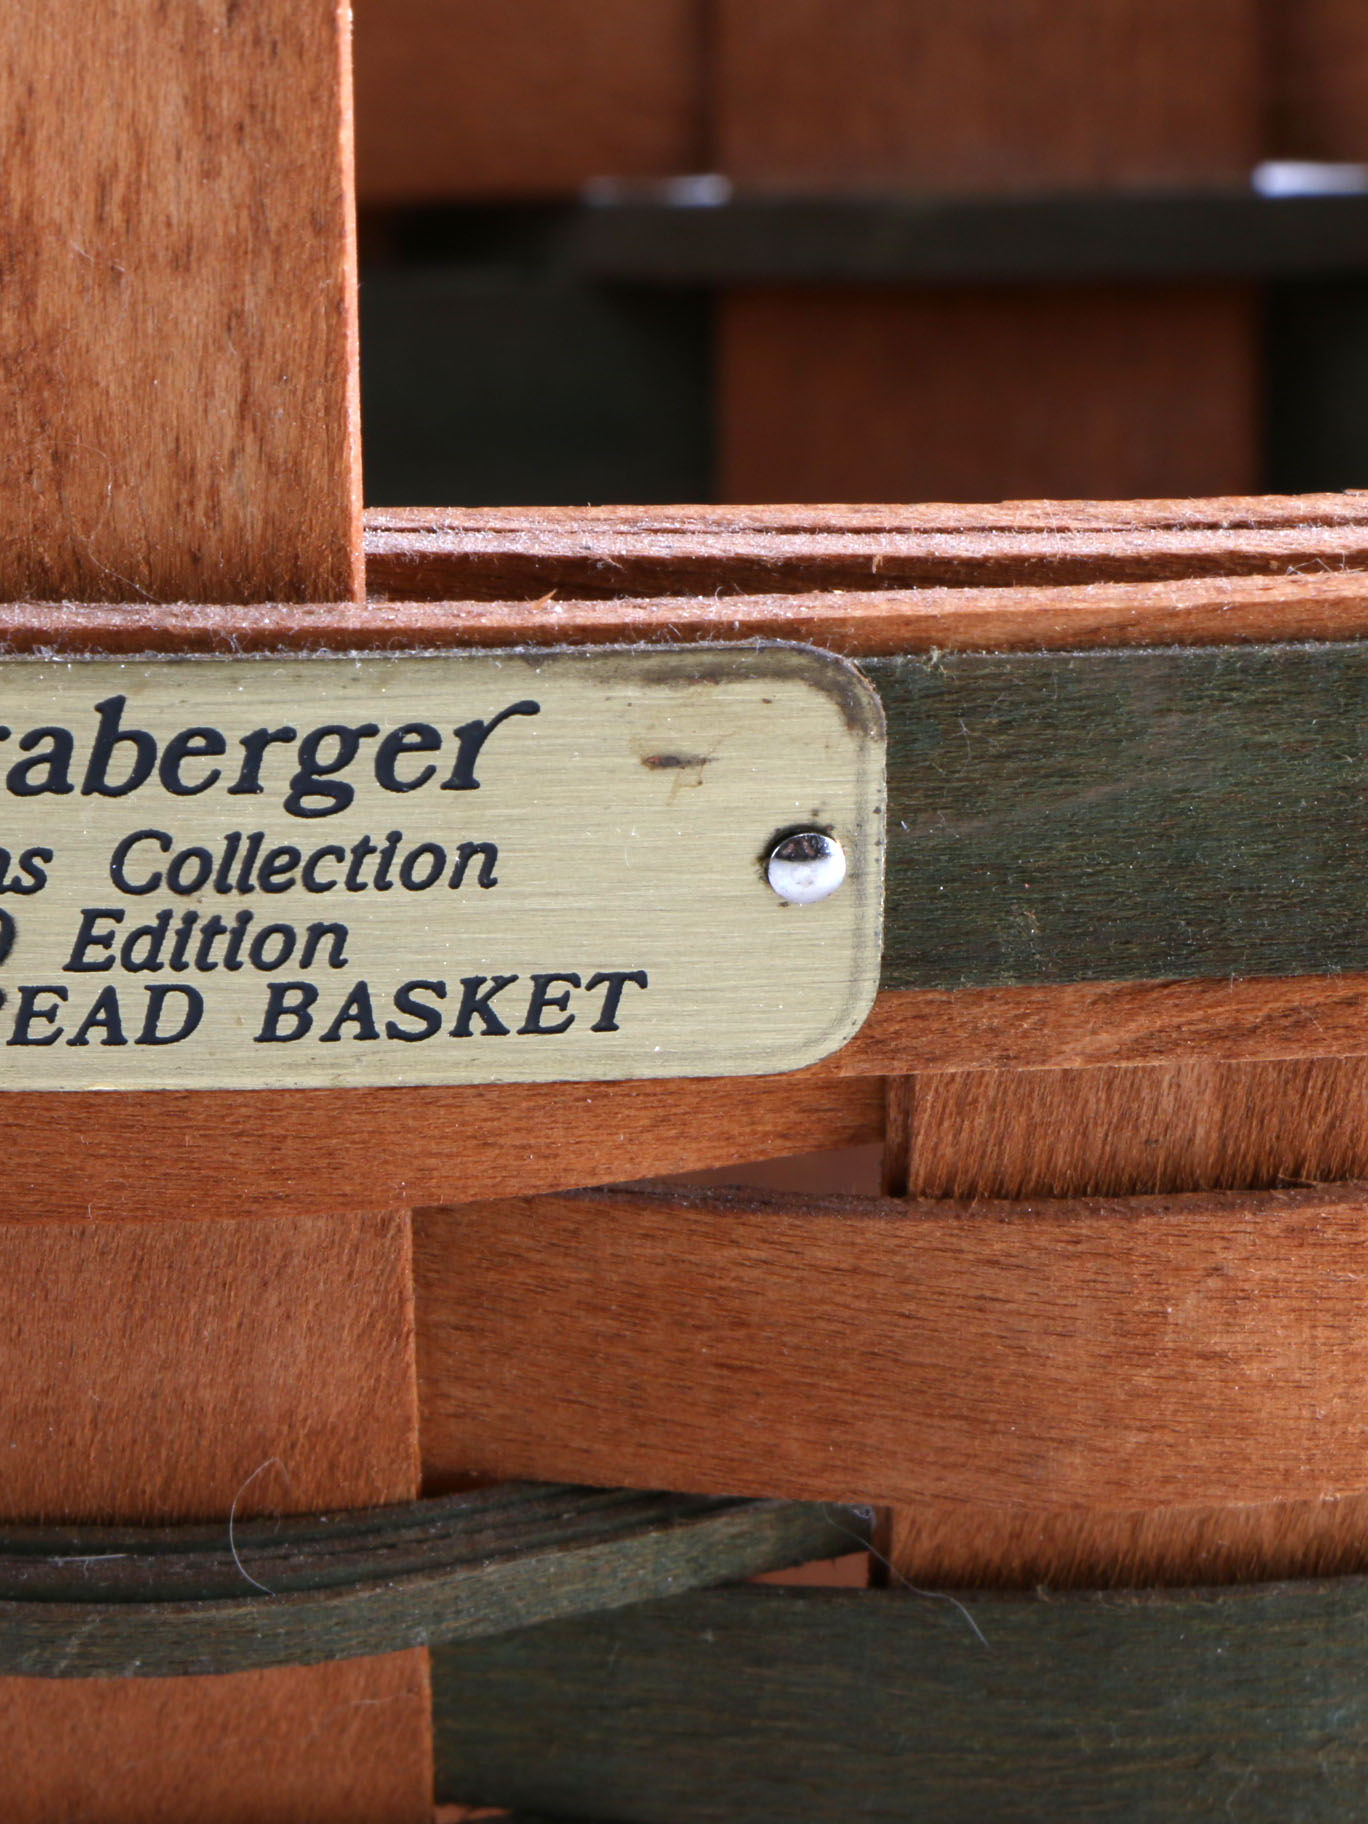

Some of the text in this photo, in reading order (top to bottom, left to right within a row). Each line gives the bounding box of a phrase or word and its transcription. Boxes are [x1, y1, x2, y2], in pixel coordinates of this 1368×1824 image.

[109, 828, 499, 897] Collection
[61, 908, 349, 974] Edition
[253, 970, 648, 1044] BASKET
